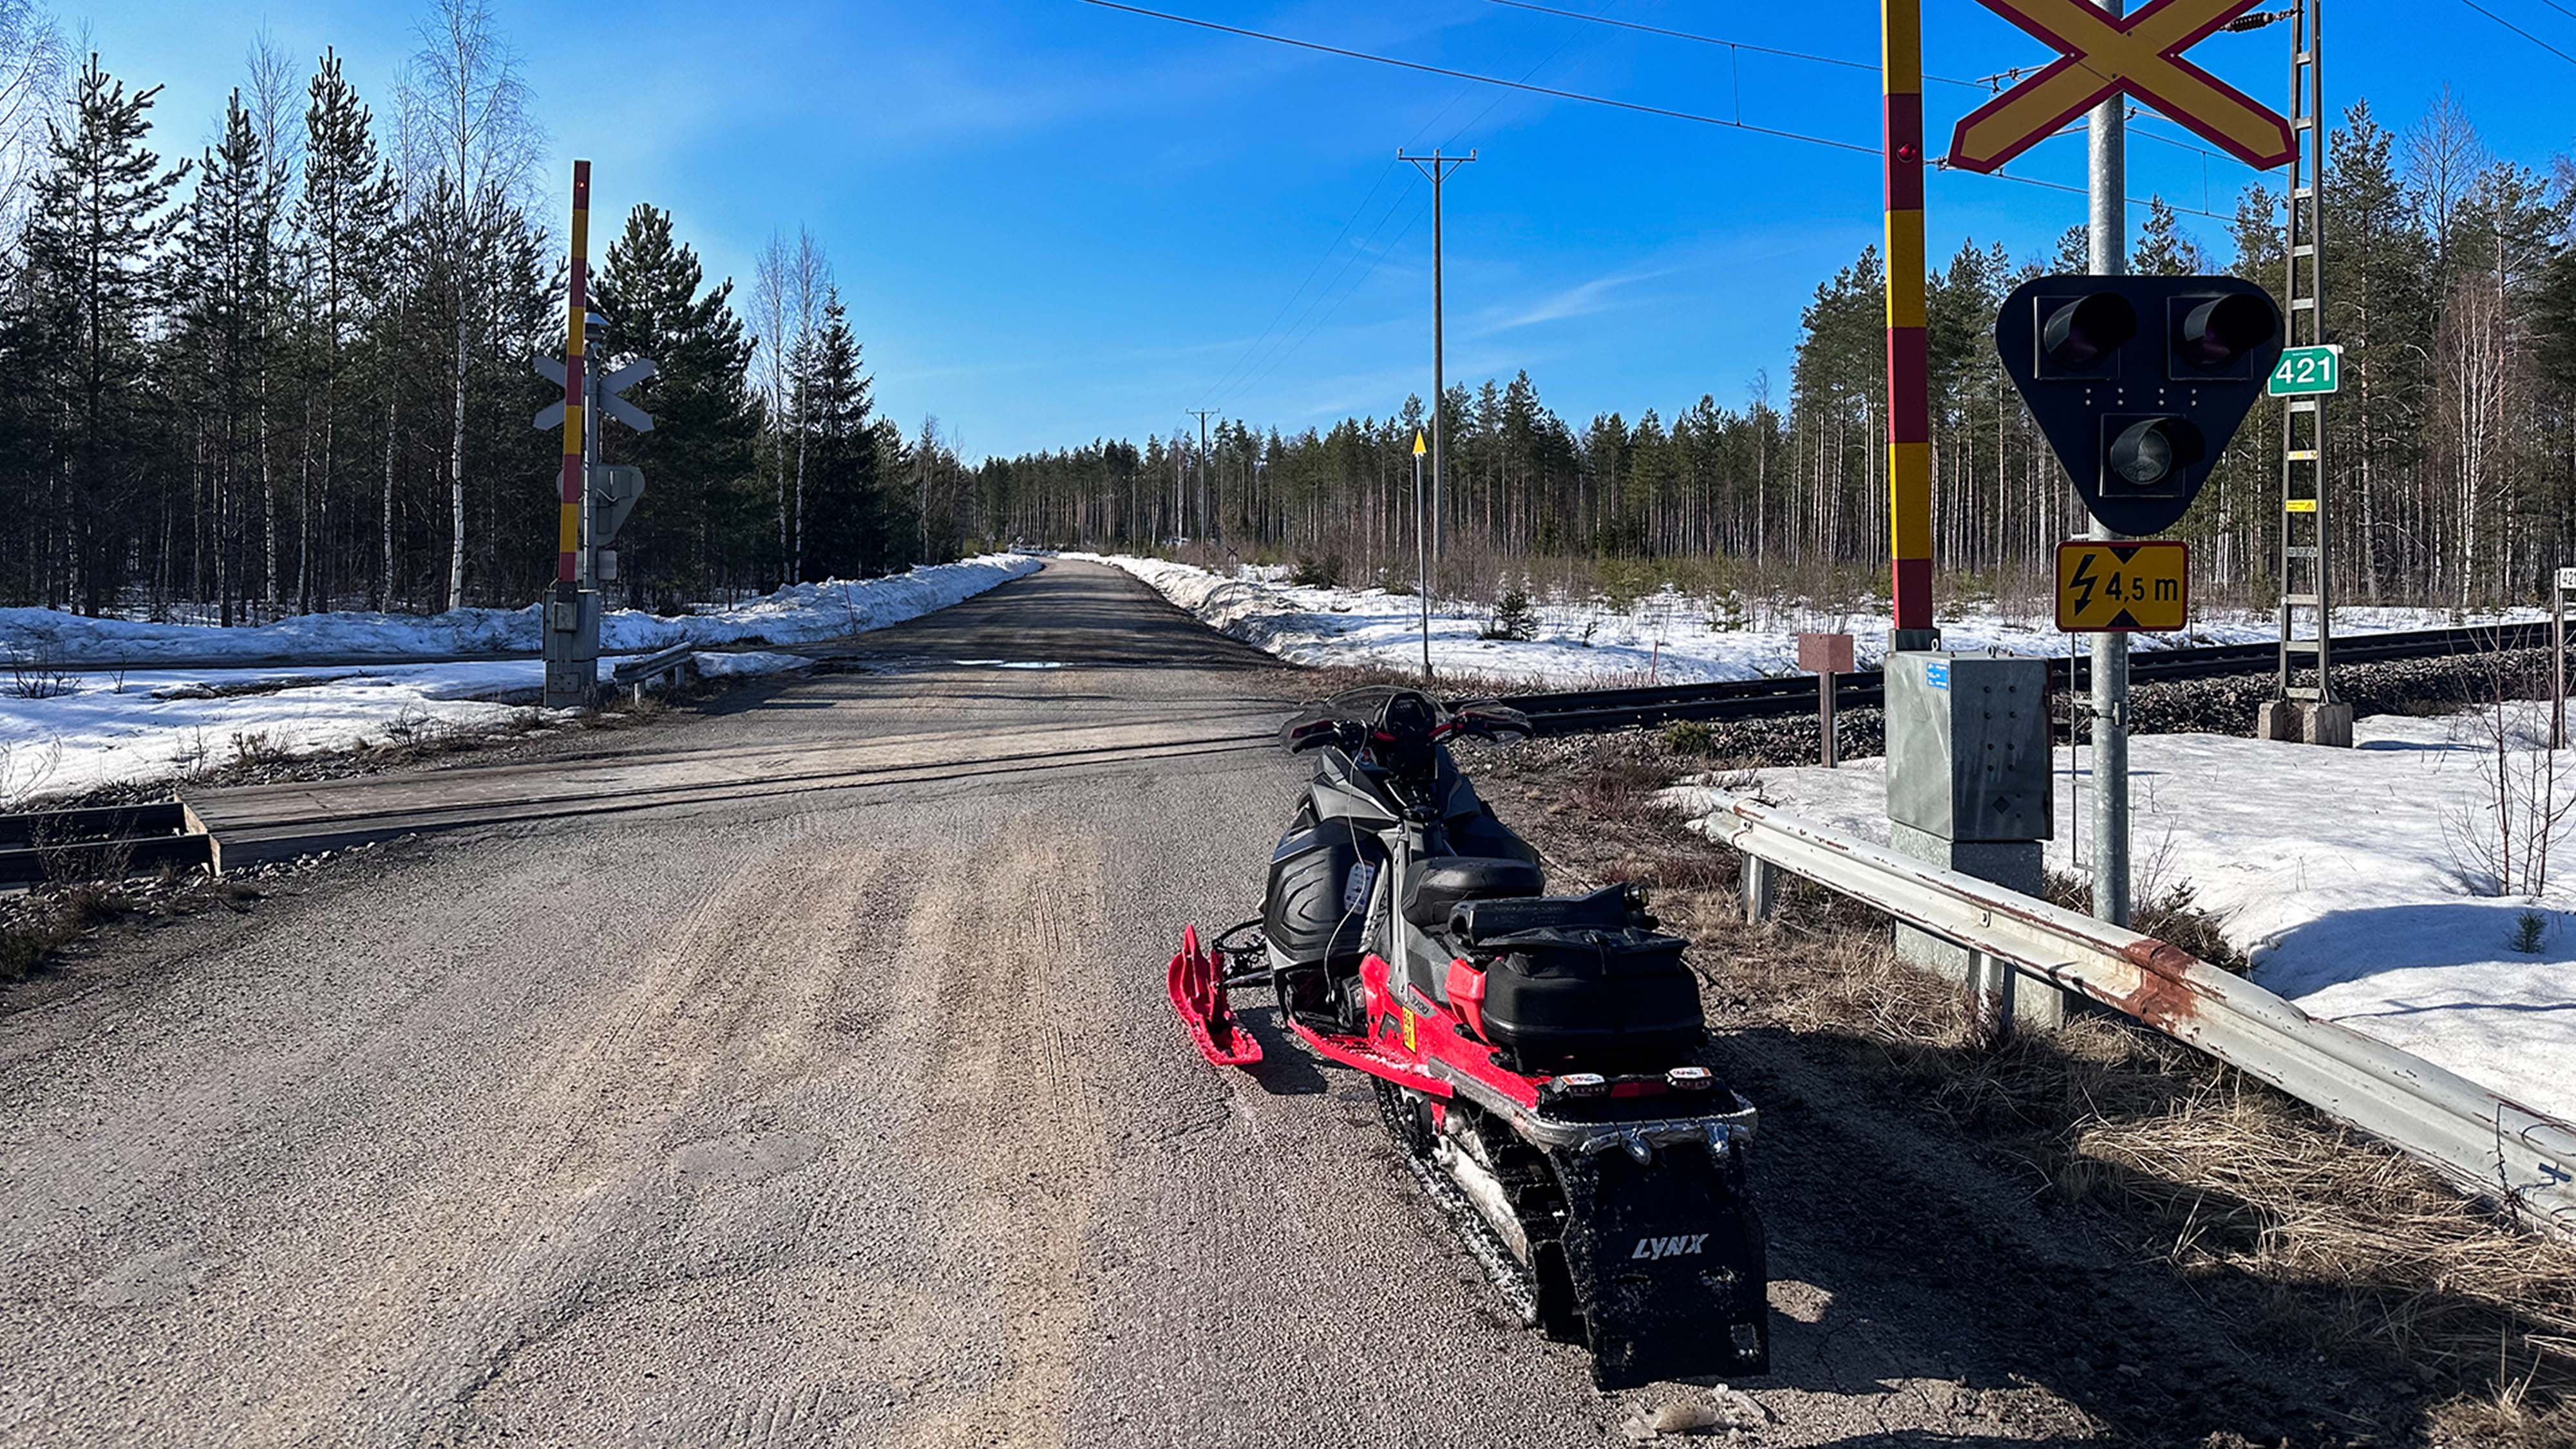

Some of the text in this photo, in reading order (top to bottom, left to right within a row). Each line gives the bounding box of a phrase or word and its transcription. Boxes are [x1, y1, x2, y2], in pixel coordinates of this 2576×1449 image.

[2275, 355, 2330, 384] 421
[2105, 571, 2178, 603] 4,5 m
[1631, 1233, 1710, 1261] LYNX
